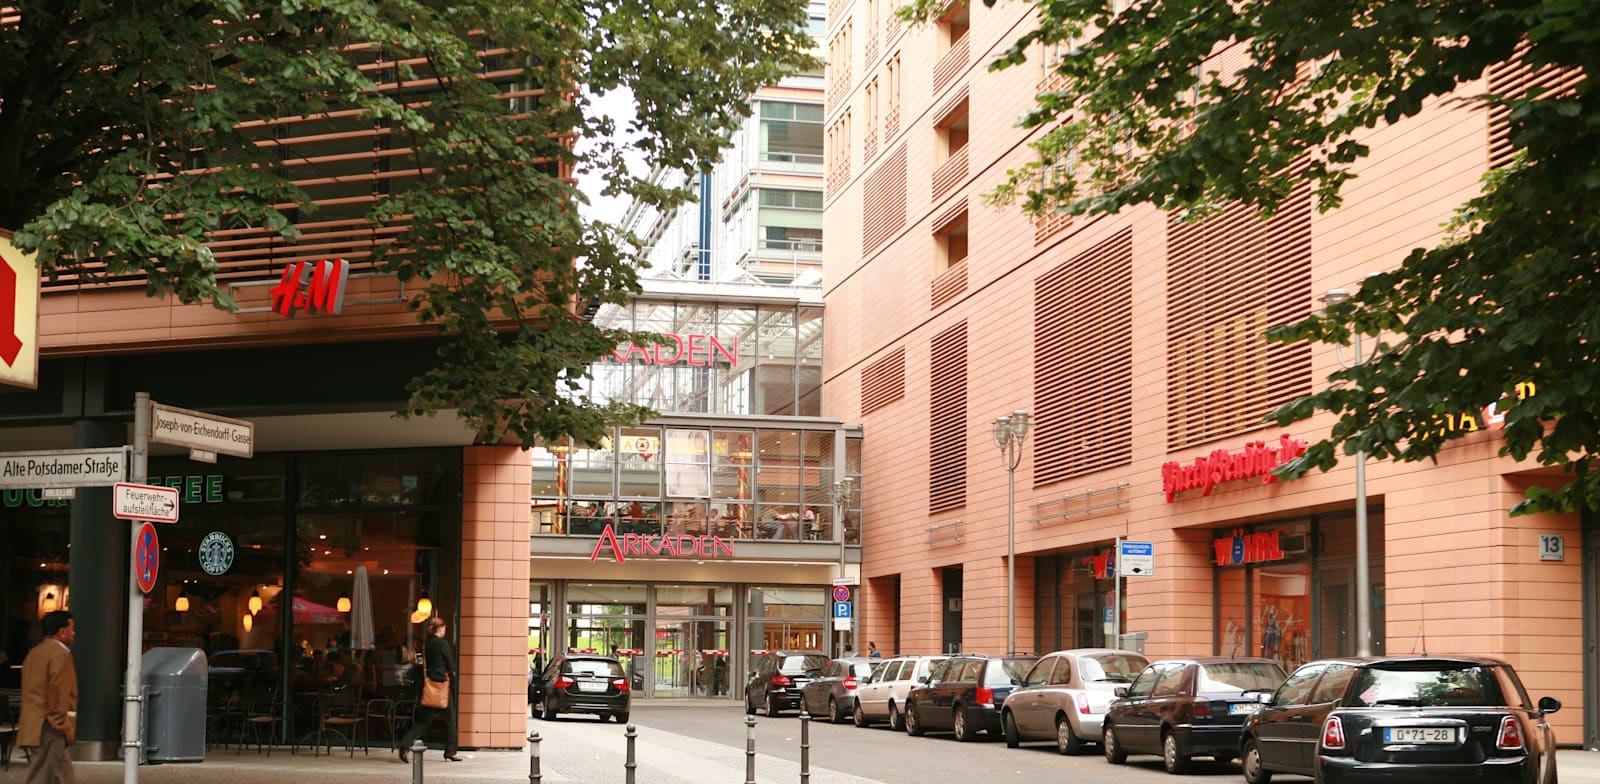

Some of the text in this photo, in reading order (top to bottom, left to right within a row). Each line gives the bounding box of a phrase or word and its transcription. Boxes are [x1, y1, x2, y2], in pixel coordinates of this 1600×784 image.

[269, 258, 348, 318] H&M
[3, 456, 119, 477] Alte Potsdamer Straße
[126, 488, 168, 501] Feuerwehr-
[201, 533, 233, 552] STARBUCKS
[589, 523, 735, 563] ARKADEN
[1214, 528, 1284, 566] WÖHRL
[1542, 537, 1560, 553] 13
[203, 561, 228, 573] COFFEE
[1411, 729, 1449, 740] 71-28
